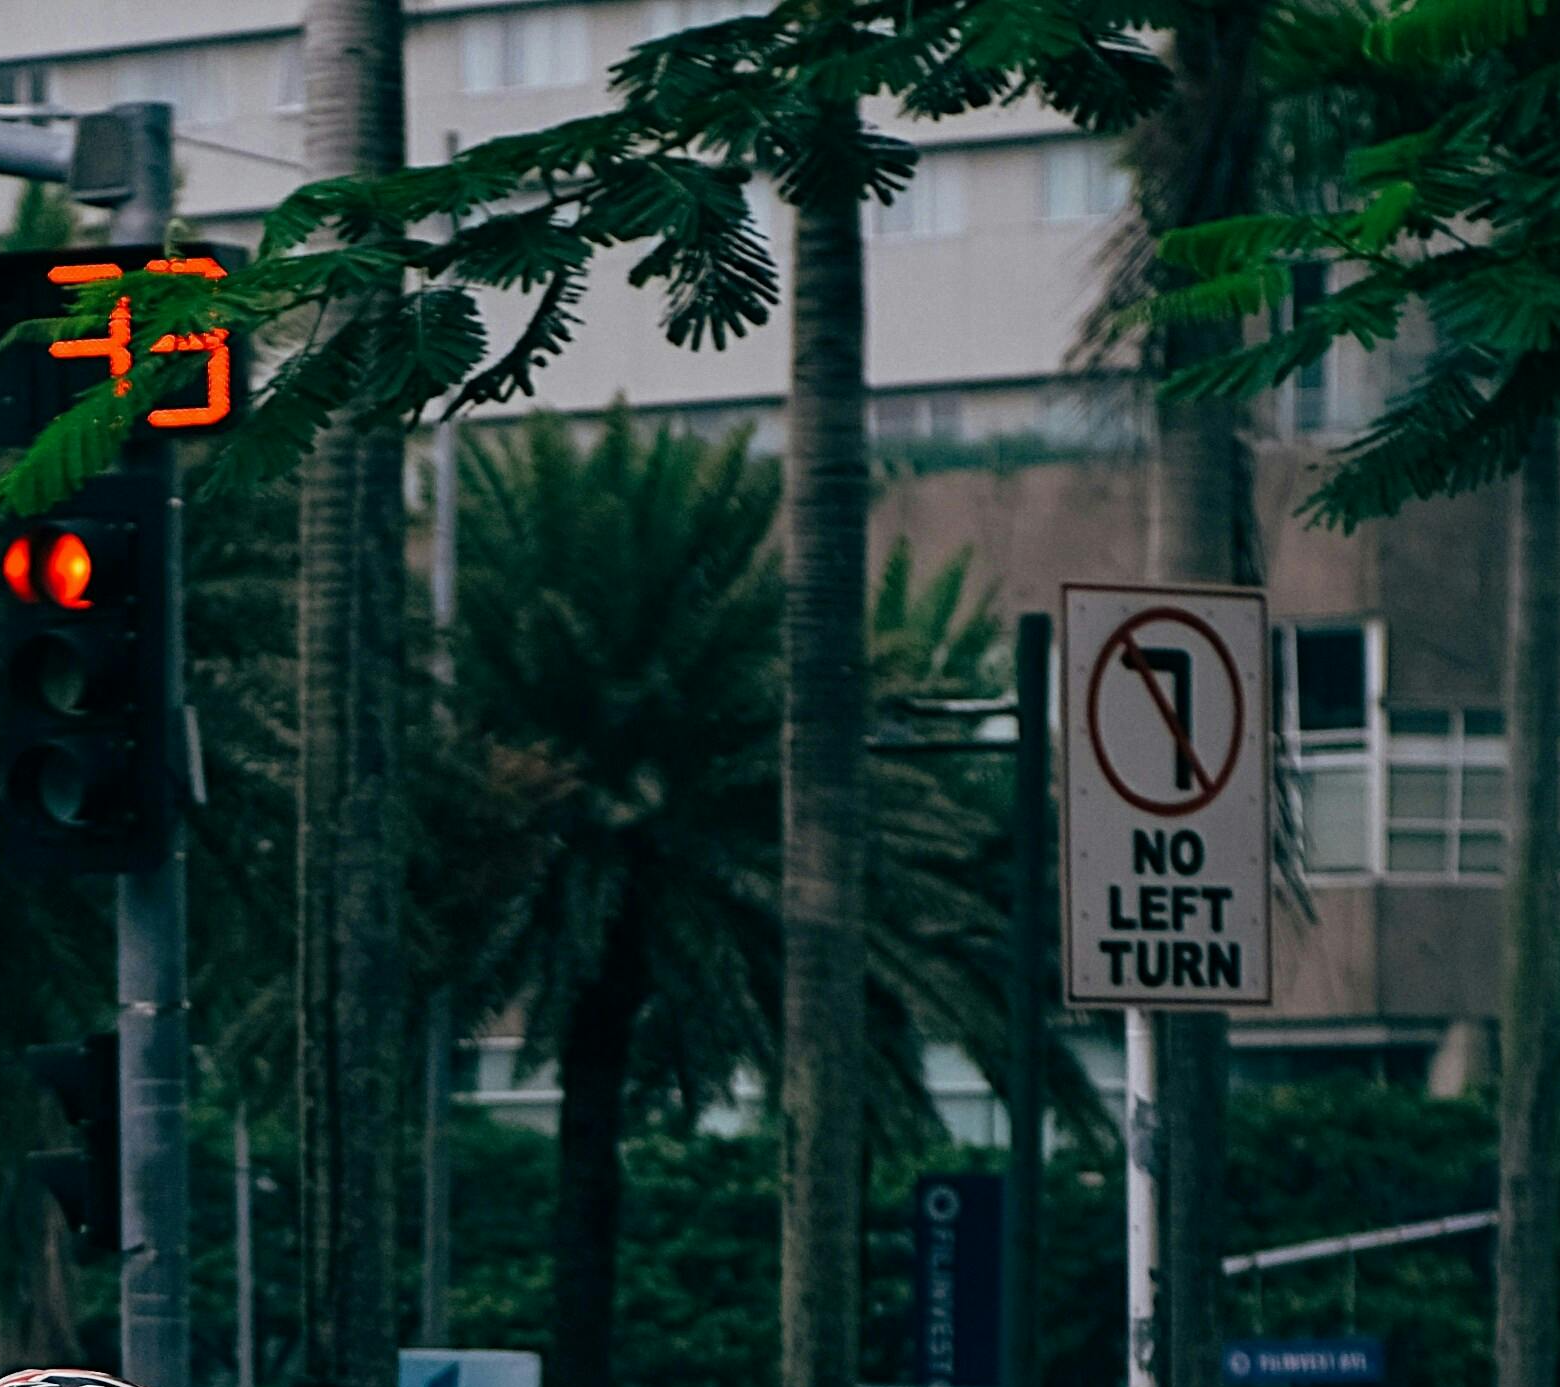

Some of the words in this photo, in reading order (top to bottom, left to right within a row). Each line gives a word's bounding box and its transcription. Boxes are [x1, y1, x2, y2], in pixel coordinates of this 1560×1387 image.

[1132, 828, 1205, 877] NO
[1108, 885, 1234, 934] LEFT
[1098, 939, 1243, 990] TURN
